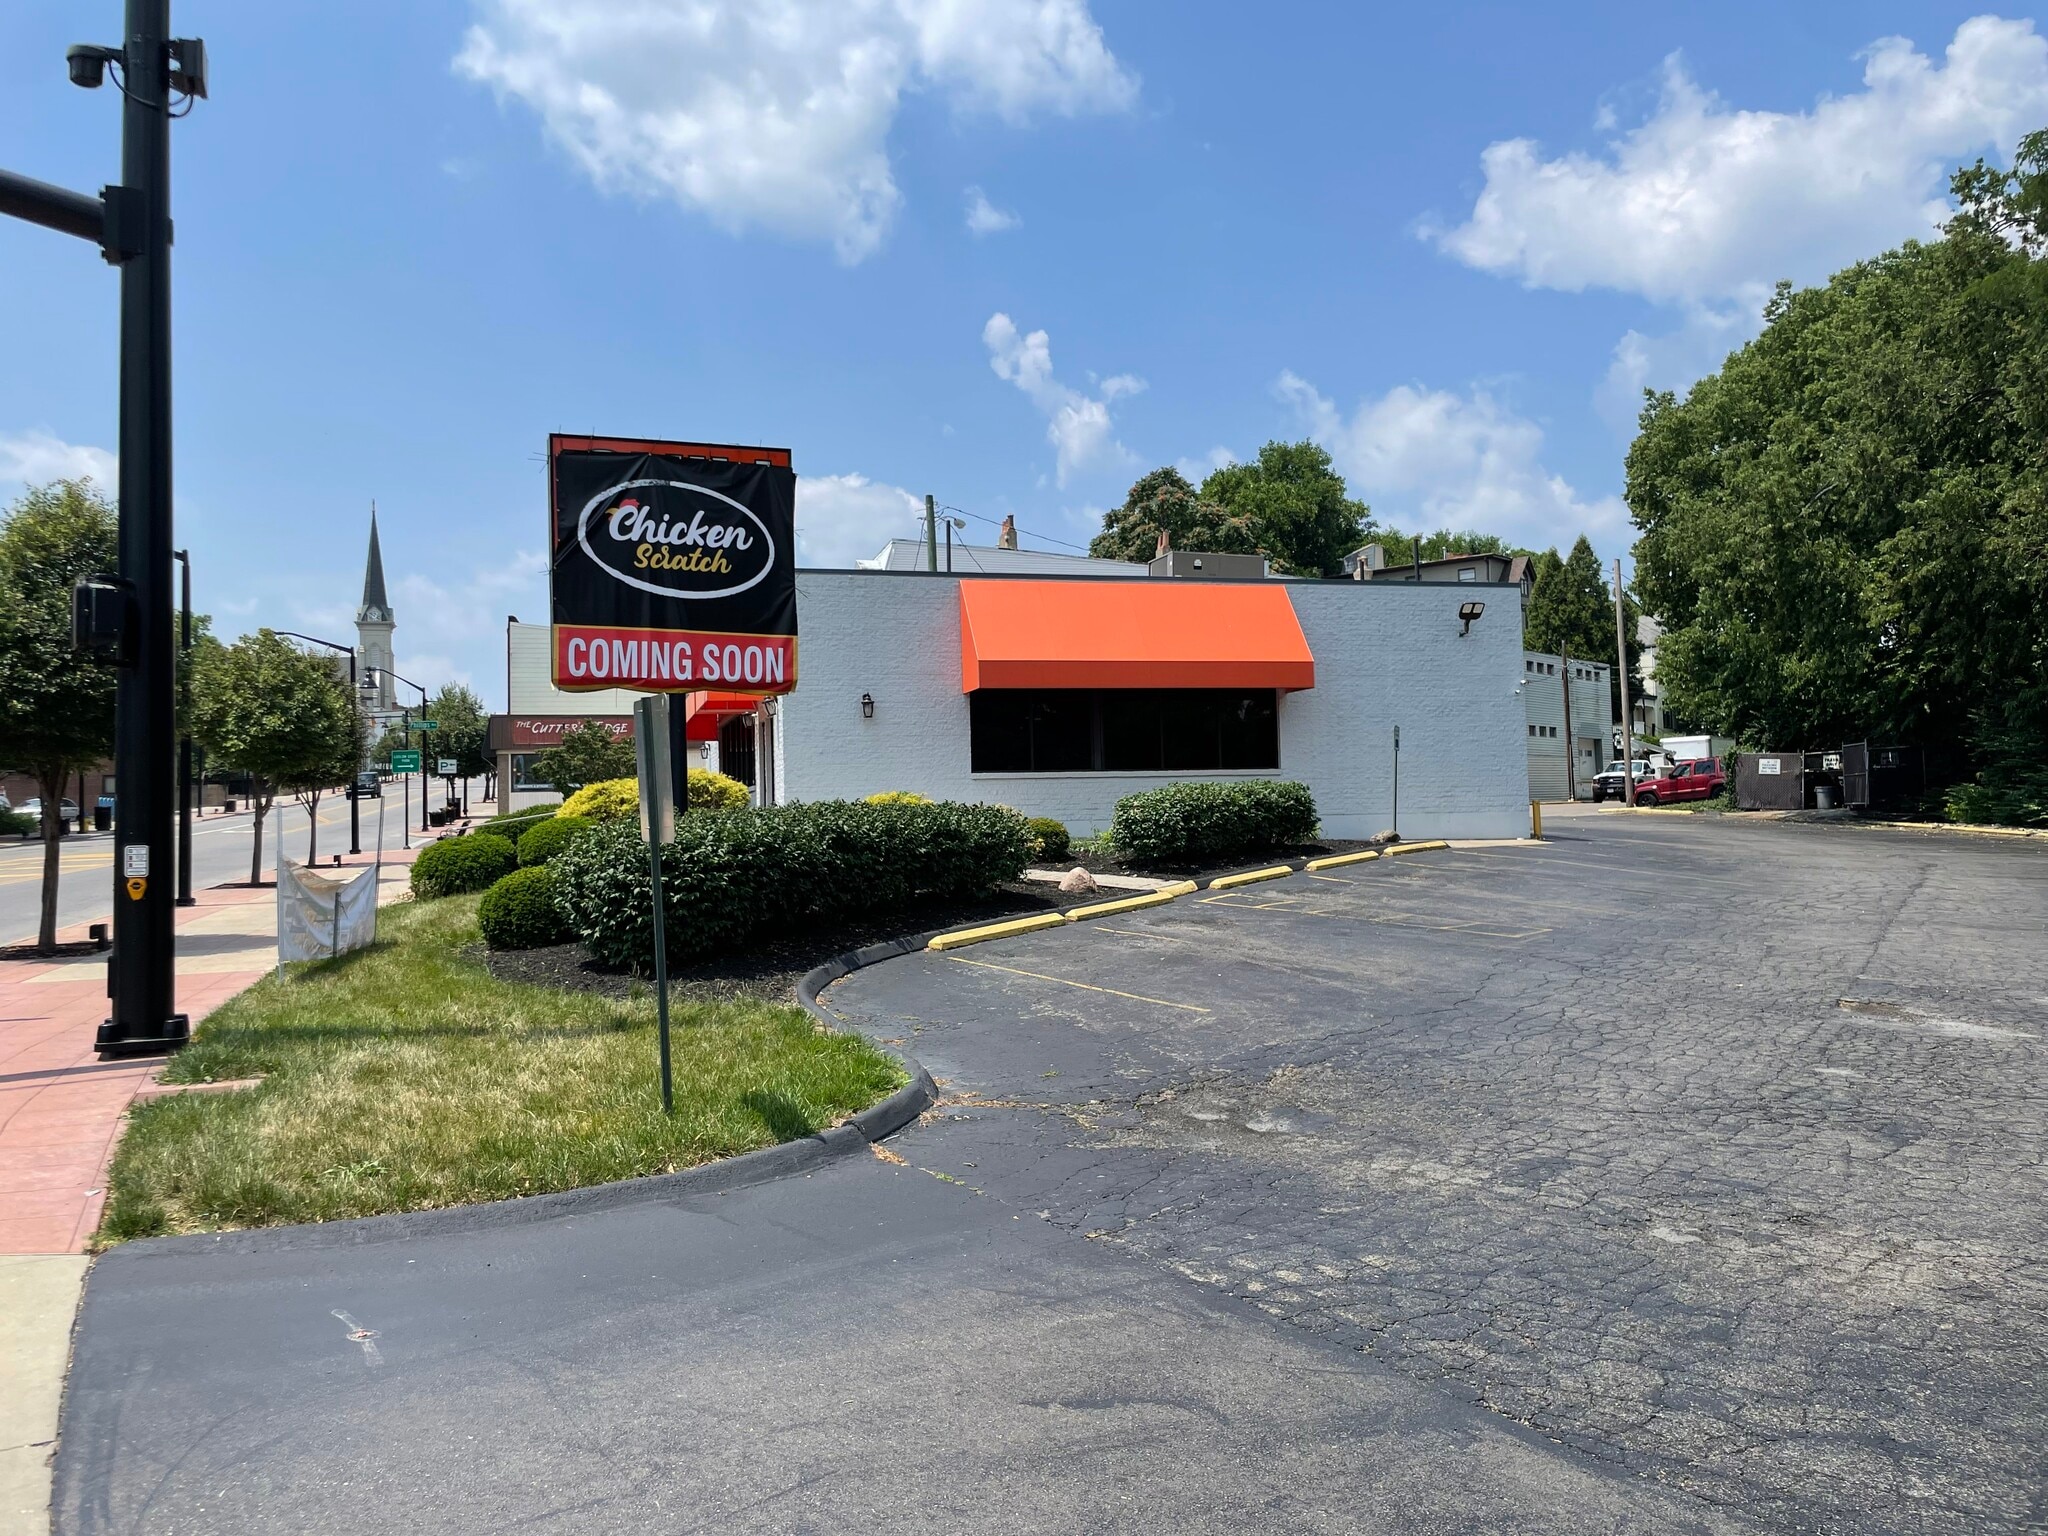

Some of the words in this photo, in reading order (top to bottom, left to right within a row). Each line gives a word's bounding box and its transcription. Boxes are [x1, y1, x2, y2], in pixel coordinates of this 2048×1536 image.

[608, 505, 754, 551] Chicken
[633, 542, 732, 574] Scratch
[568, 637, 693, 681] COMING
[702, 643, 784, 684] SOON
[516, 720, 532, 728] THE
